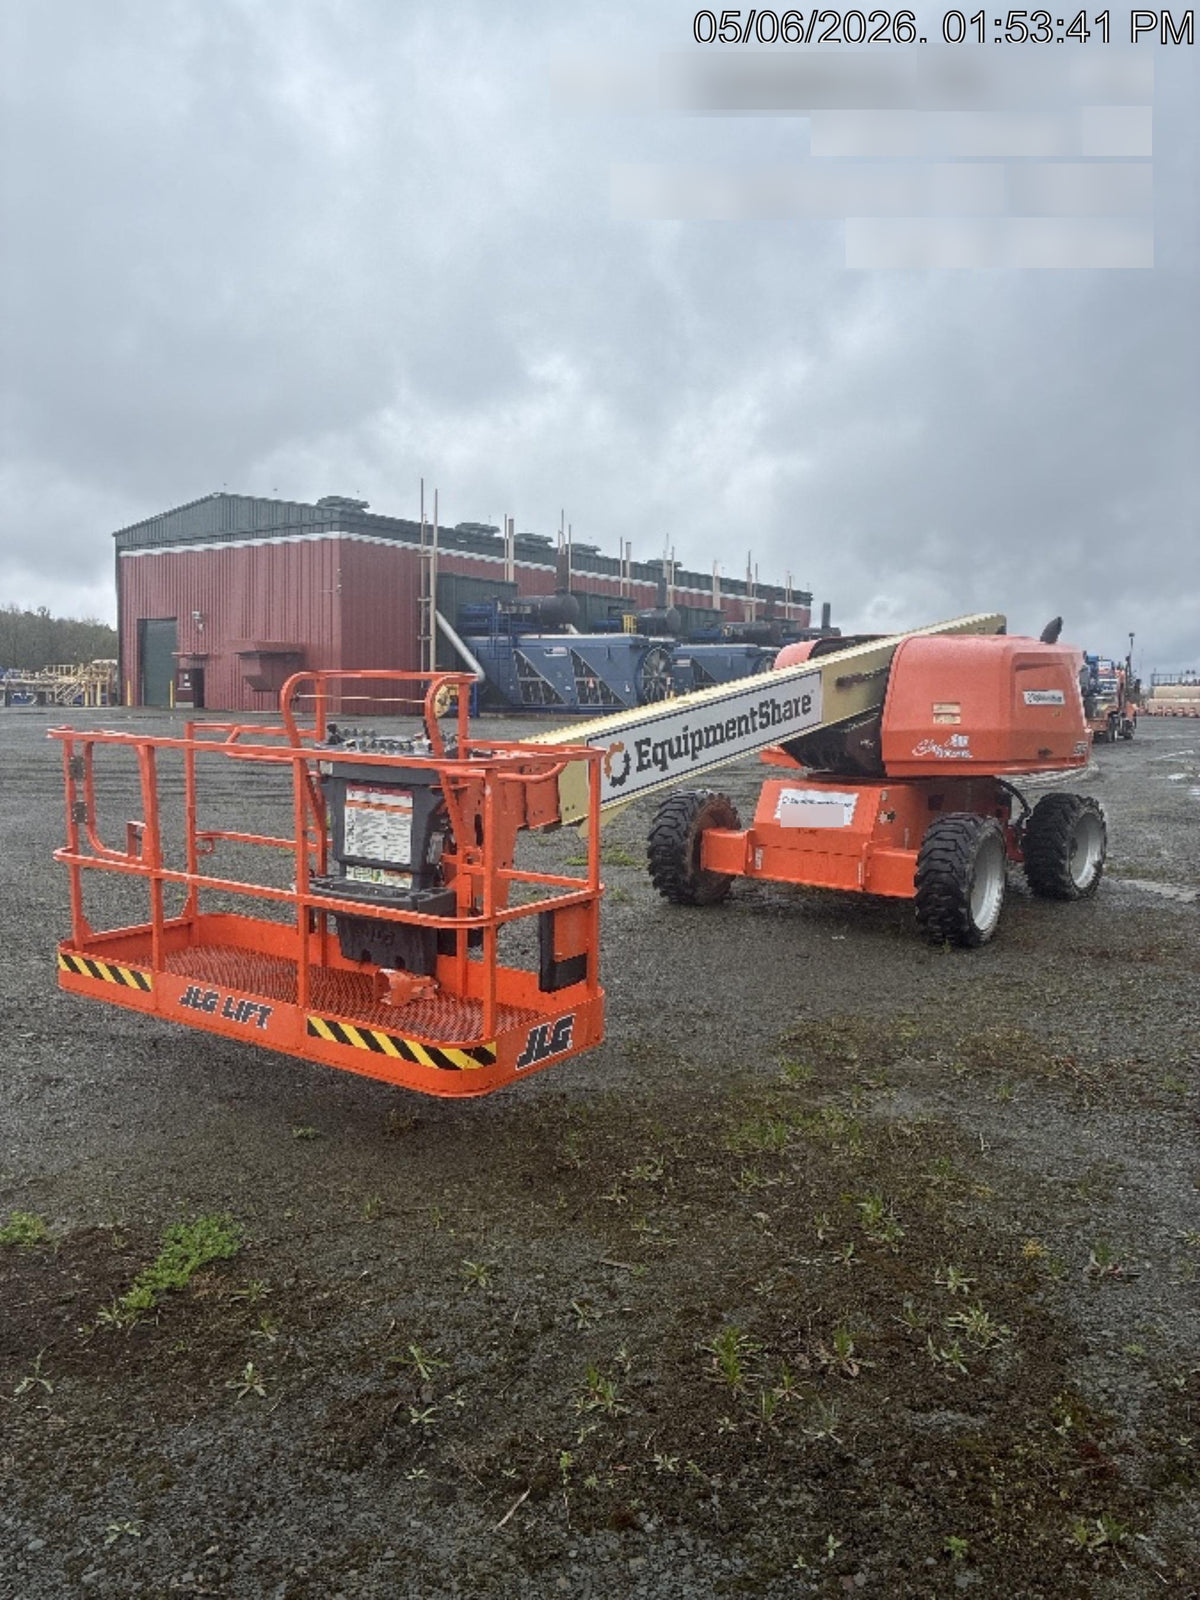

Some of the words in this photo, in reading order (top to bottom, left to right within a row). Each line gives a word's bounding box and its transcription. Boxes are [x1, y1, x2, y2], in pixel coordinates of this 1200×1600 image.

[634, 694, 812, 772] EquipmentShare
[179, 985, 220, 1014] JLG
[221, 995, 274, 1030] LIFT
[515, 1013, 575, 1070] JLG
